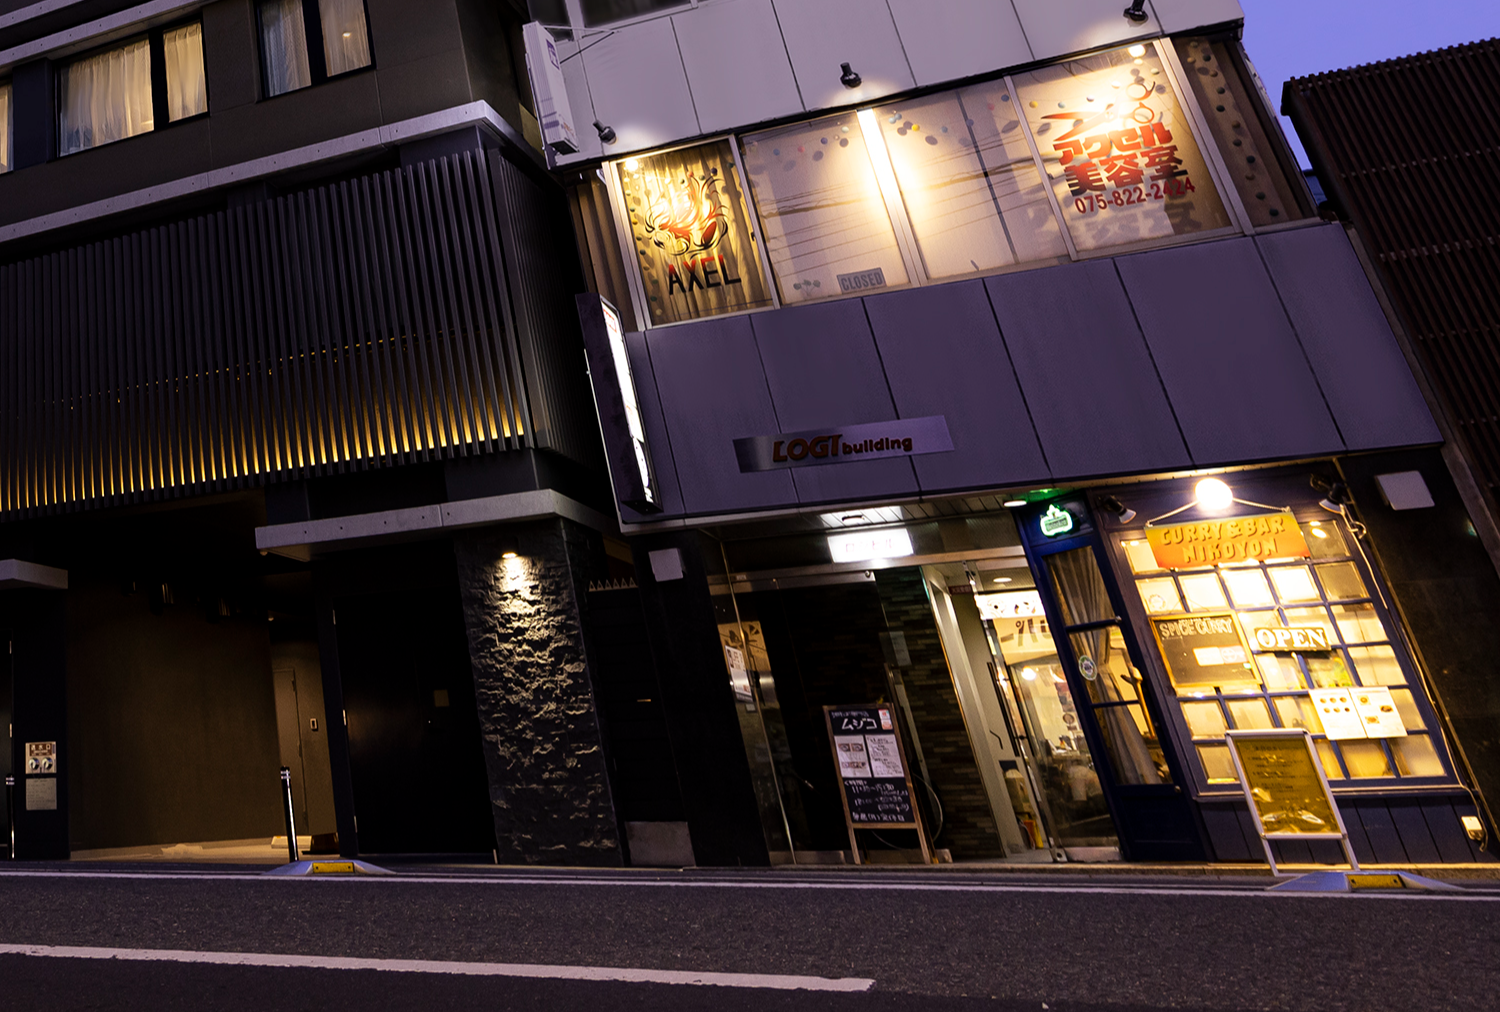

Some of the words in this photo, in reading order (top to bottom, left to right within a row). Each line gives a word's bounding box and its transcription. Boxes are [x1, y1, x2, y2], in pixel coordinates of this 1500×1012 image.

[1052, 121, 1173, 166] アクセル
[1063, 144, 1189, 197] 美容室
[1074, 176, 1196, 214] 075-822-2424
[668, 254, 742, 295] AXEL
[840, 271, 883, 291] CLOSED
[842, 437, 913, 455] building
[1160, 523, 1223, 545] CURRY
[1242, 515, 1286, 537] BAR
[1159, 620, 1197, 638] SPICE
[1256, 628, 1327, 648] OPEN
[841, 718, 878, 731] ムジコ
